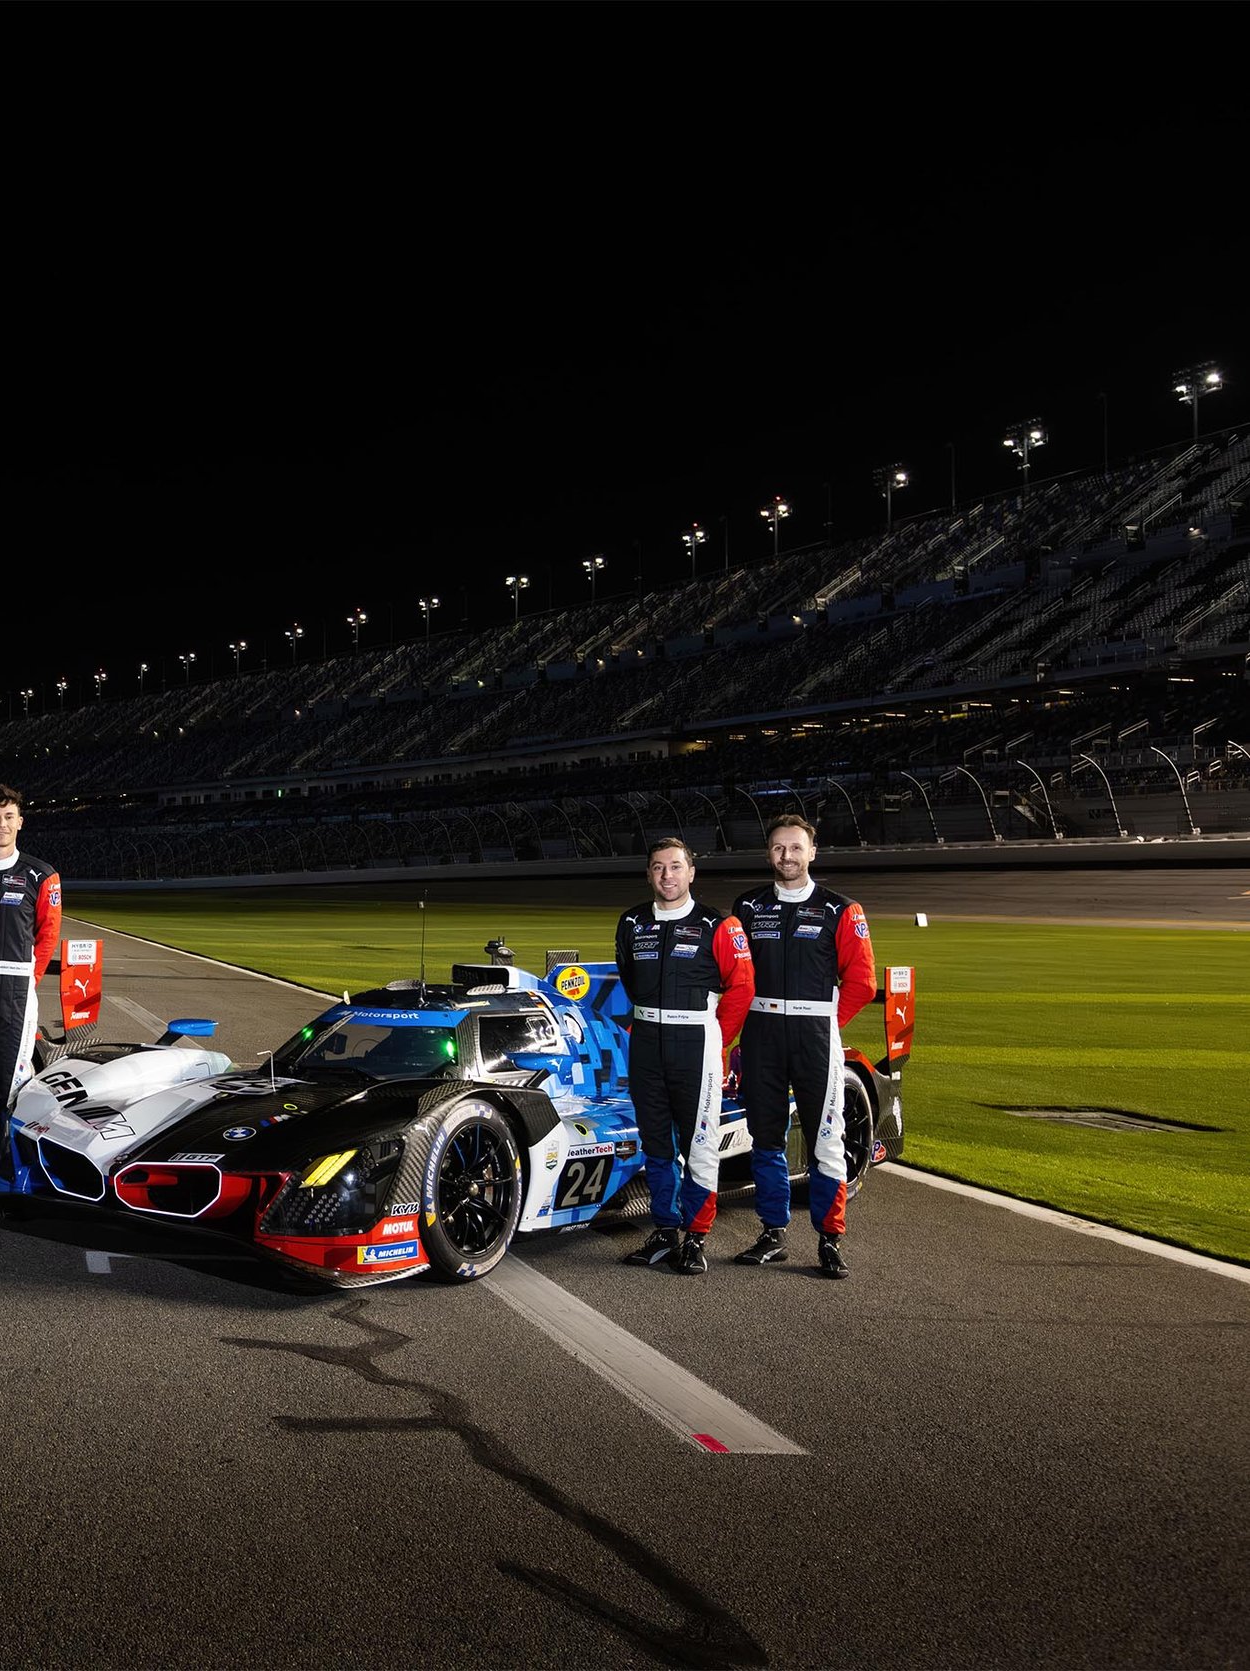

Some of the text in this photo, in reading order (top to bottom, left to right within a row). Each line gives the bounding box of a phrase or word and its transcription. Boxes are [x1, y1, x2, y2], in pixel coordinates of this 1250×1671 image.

[354, 1011, 419, 1019] Motorsport
[704, 1072, 713, 1112] Motorsport
[830, 1066, 838, 1107] Motorsport
[567, 1145, 613, 1157] eatherTech
[426, 1131, 445, 1198] MICHELIN
[561, 1159, 606, 1207] 24
[391, 1202, 419, 1216] KYB
[382, 1221, 414, 1235] MOTUL
[378, 1246, 414, 1258] MICHELIN
